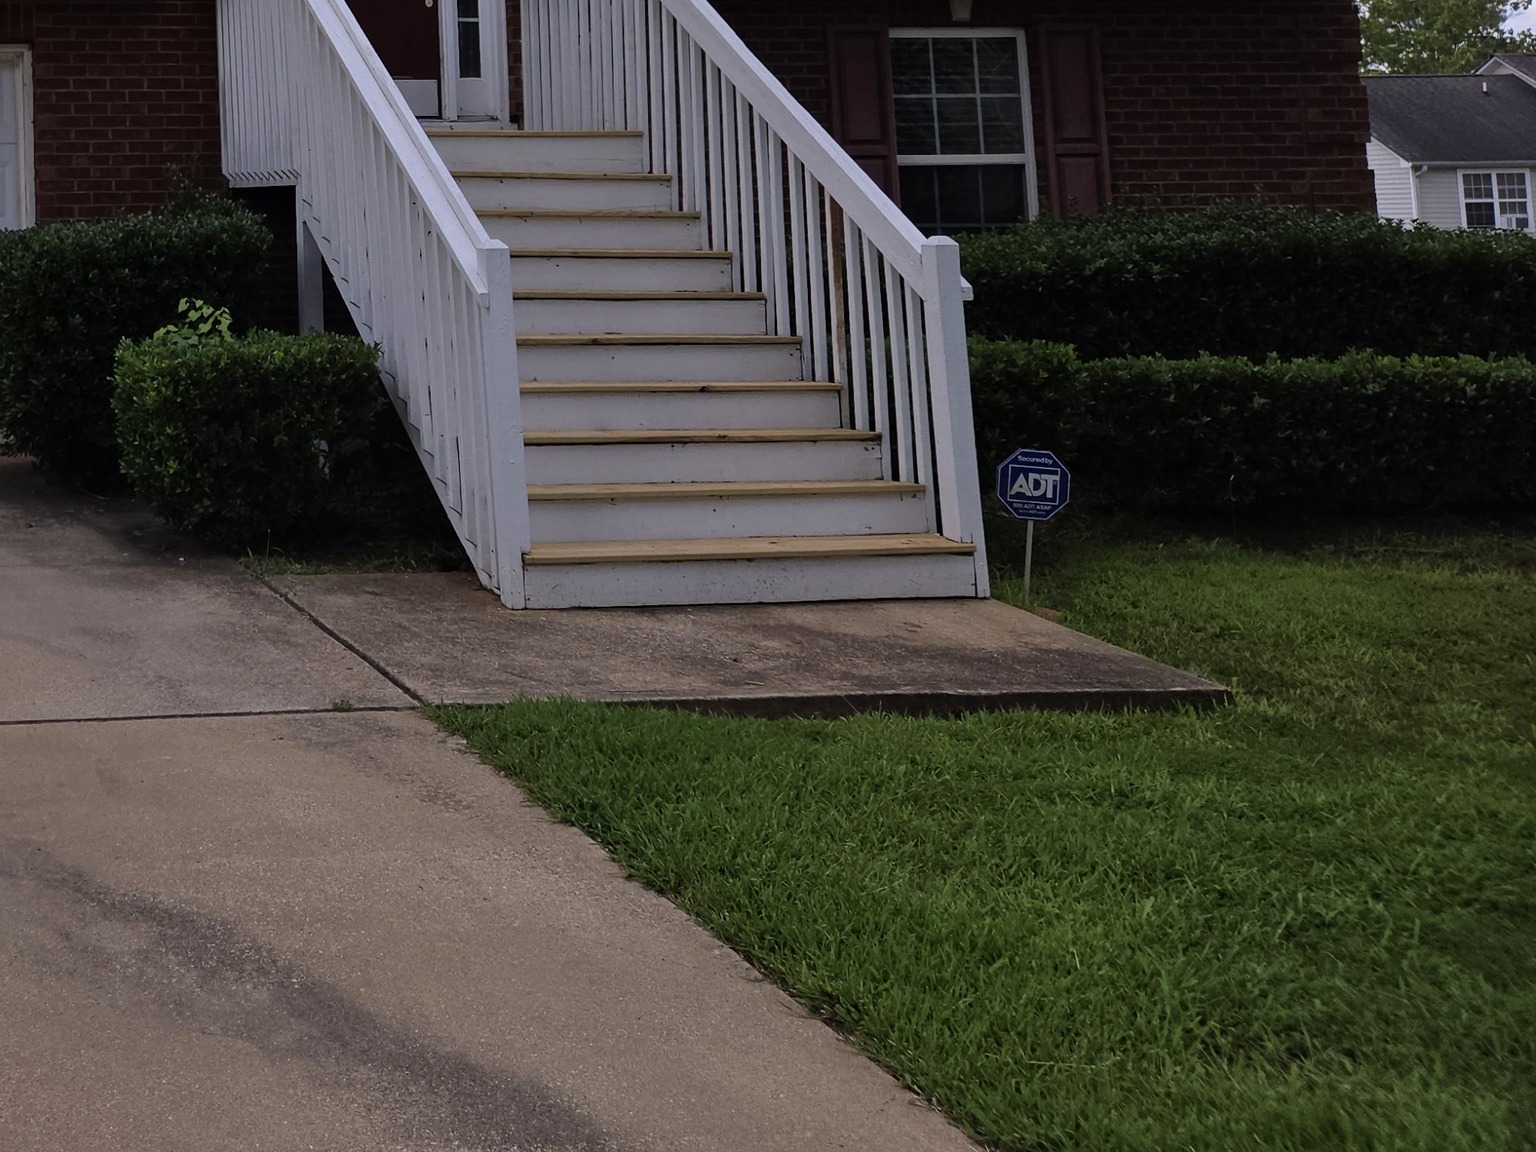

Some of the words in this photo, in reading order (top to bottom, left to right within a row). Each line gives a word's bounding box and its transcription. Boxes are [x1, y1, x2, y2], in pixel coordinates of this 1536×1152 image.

[1017, 455, 1044, 463] Secured
[1045, 457, 1053, 465] by
[1009, 472, 1059, 498] ADT
